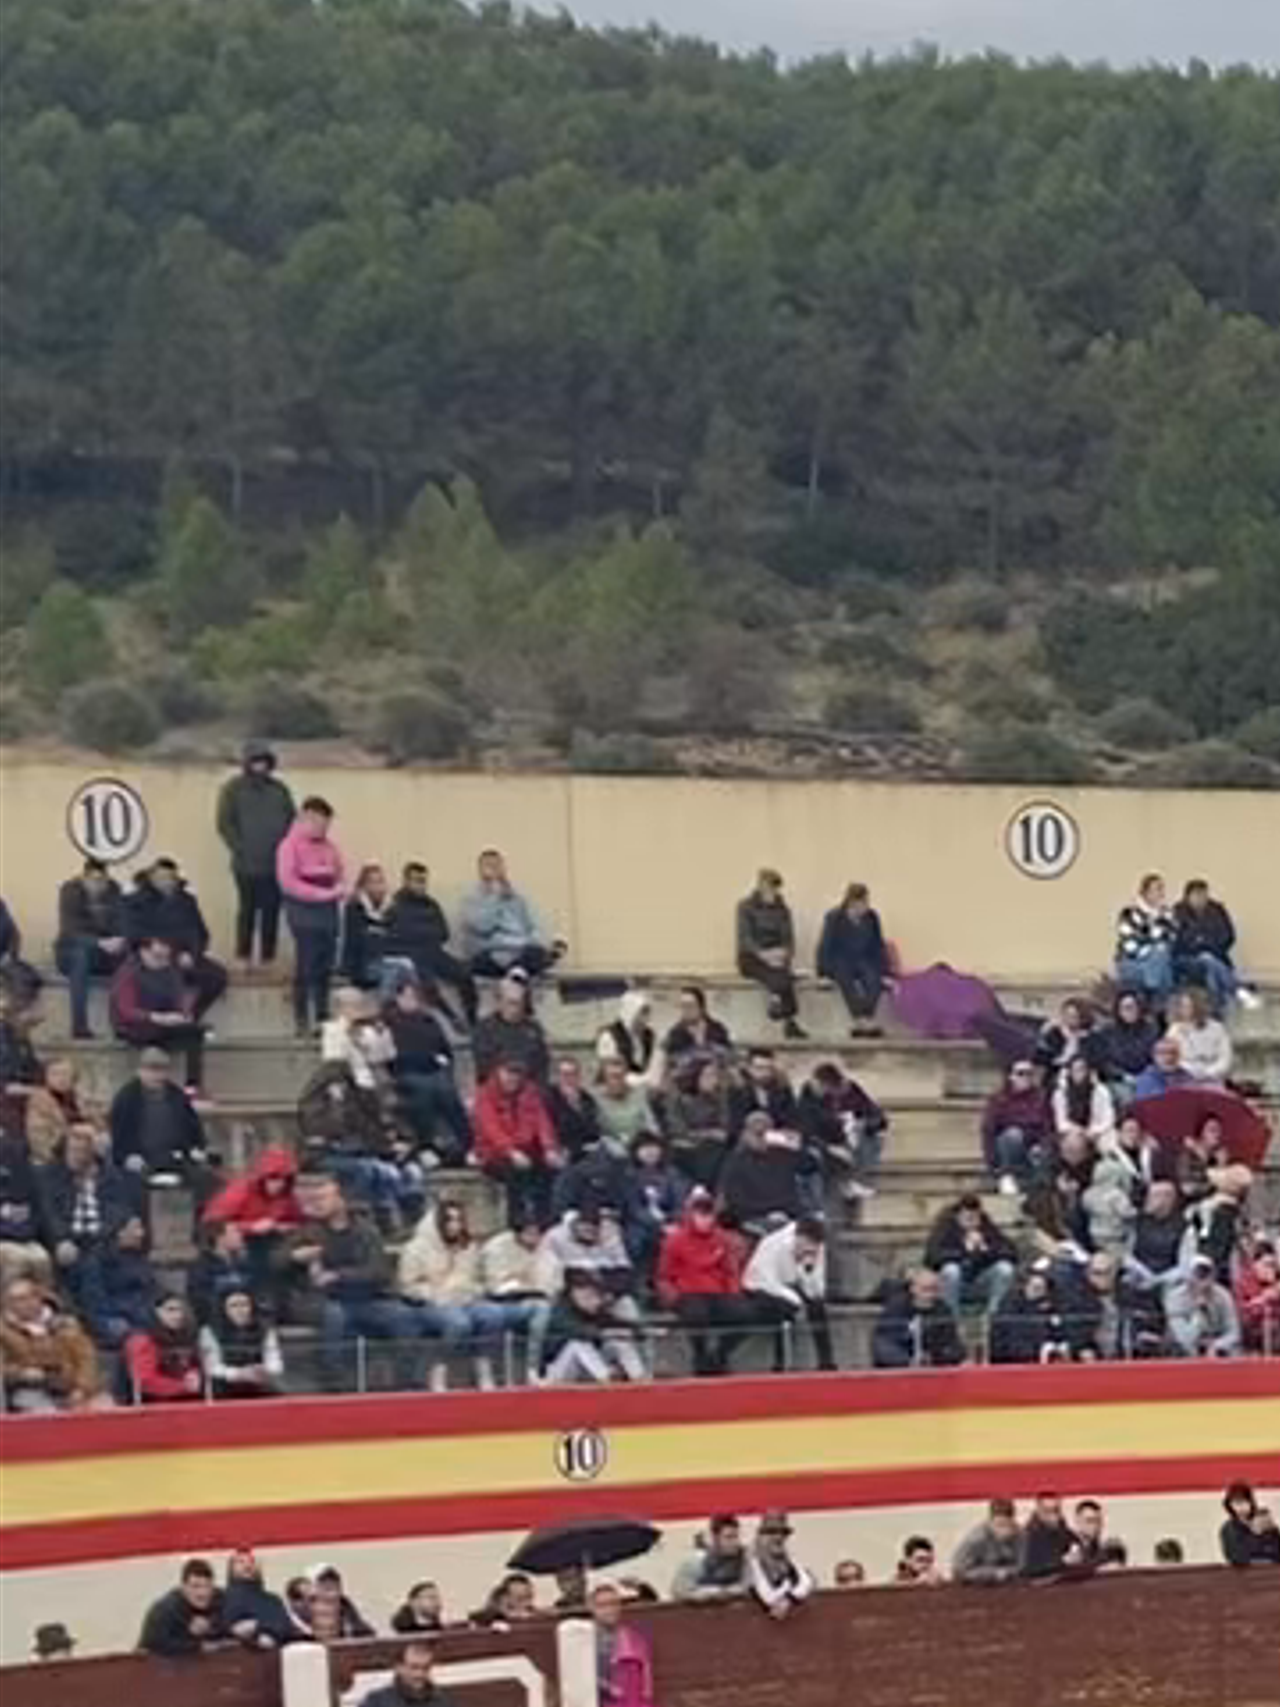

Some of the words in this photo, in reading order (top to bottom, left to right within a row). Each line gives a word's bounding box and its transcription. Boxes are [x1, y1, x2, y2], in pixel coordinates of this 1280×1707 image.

[80, 791, 132, 848] 10
[1019, 812, 1065, 864] 10
[563, 1434, 597, 1473] 10
